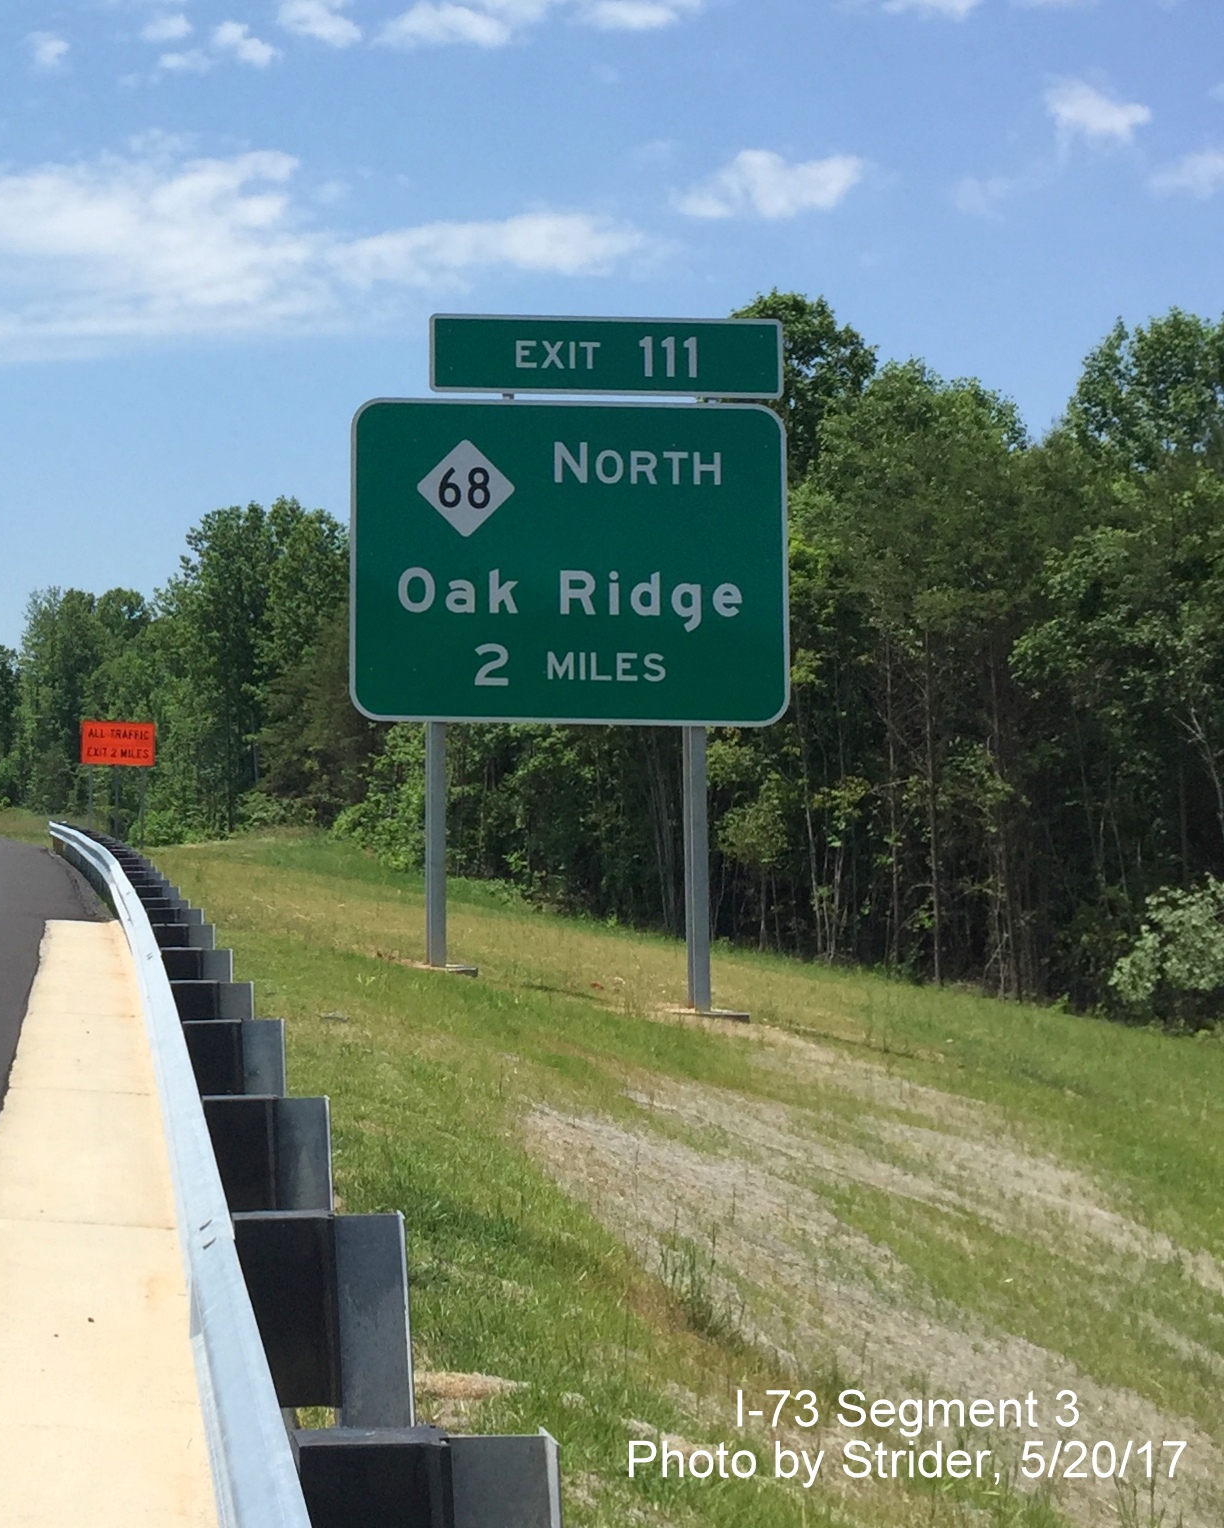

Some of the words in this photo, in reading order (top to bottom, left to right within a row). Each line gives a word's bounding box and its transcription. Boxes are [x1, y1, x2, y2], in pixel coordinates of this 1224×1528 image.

[515, 340, 601, 369] EXIT
[639, 336, 698, 378] 111
[554, 441, 722, 486] NORTH
[437, 466, 491, 510] 68
[398, 566, 519, 614] Oak
[560, 570, 743, 633] Ridge
[474, 643, 510, 686] 2
[547, 651, 667, 682] MILES
[87, 747, 107, 757] EXIT
[111, 748, 117, 758] 2
[121, 748, 149, 760] MILES
[88, 729, 105, 738] ALL
[110, 729, 149, 740] TRAFFIC
